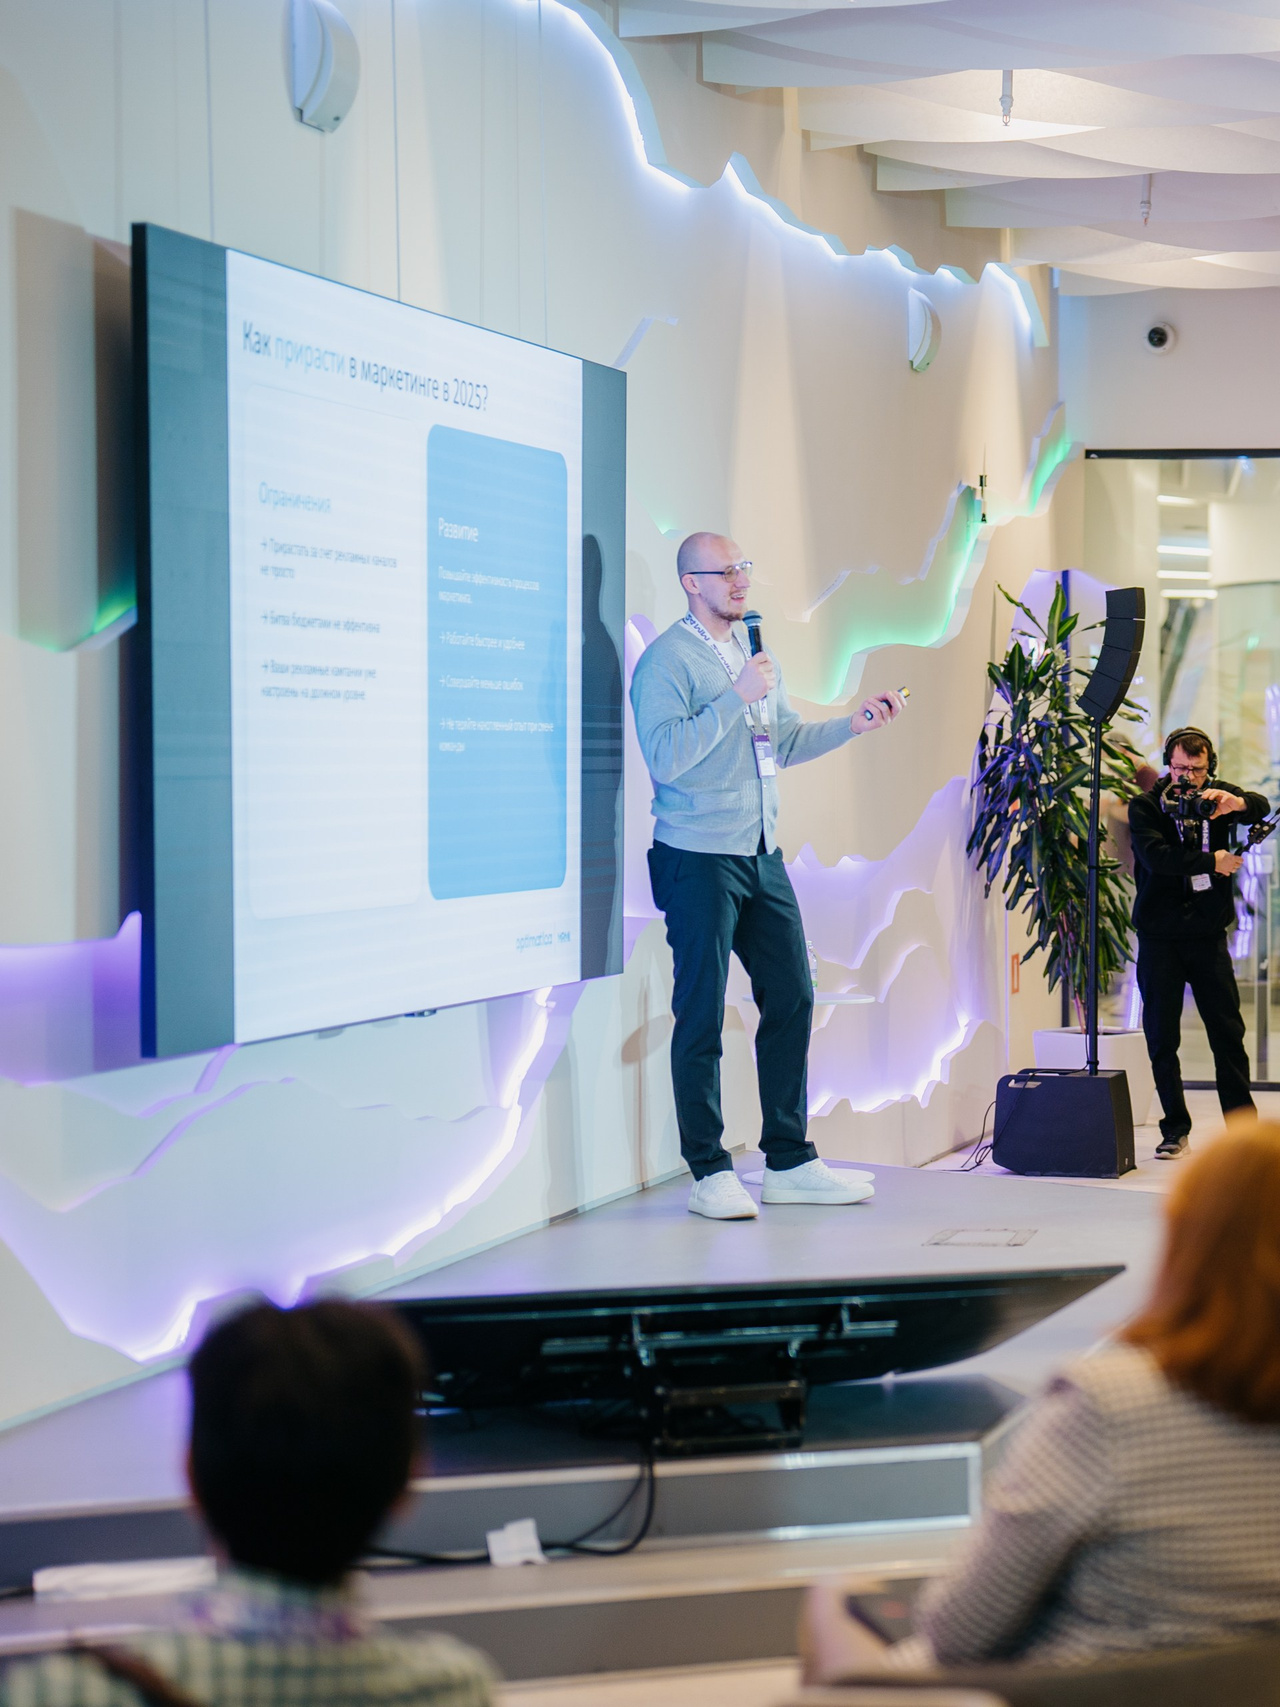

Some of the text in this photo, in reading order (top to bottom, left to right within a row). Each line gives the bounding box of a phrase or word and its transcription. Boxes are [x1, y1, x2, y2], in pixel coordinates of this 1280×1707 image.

[242, 320, 488, 411] Как прирасти в маркетинге в 2025?
[258, 481, 331, 512] Ограничения
[438, 517, 479, 542] Развитие
